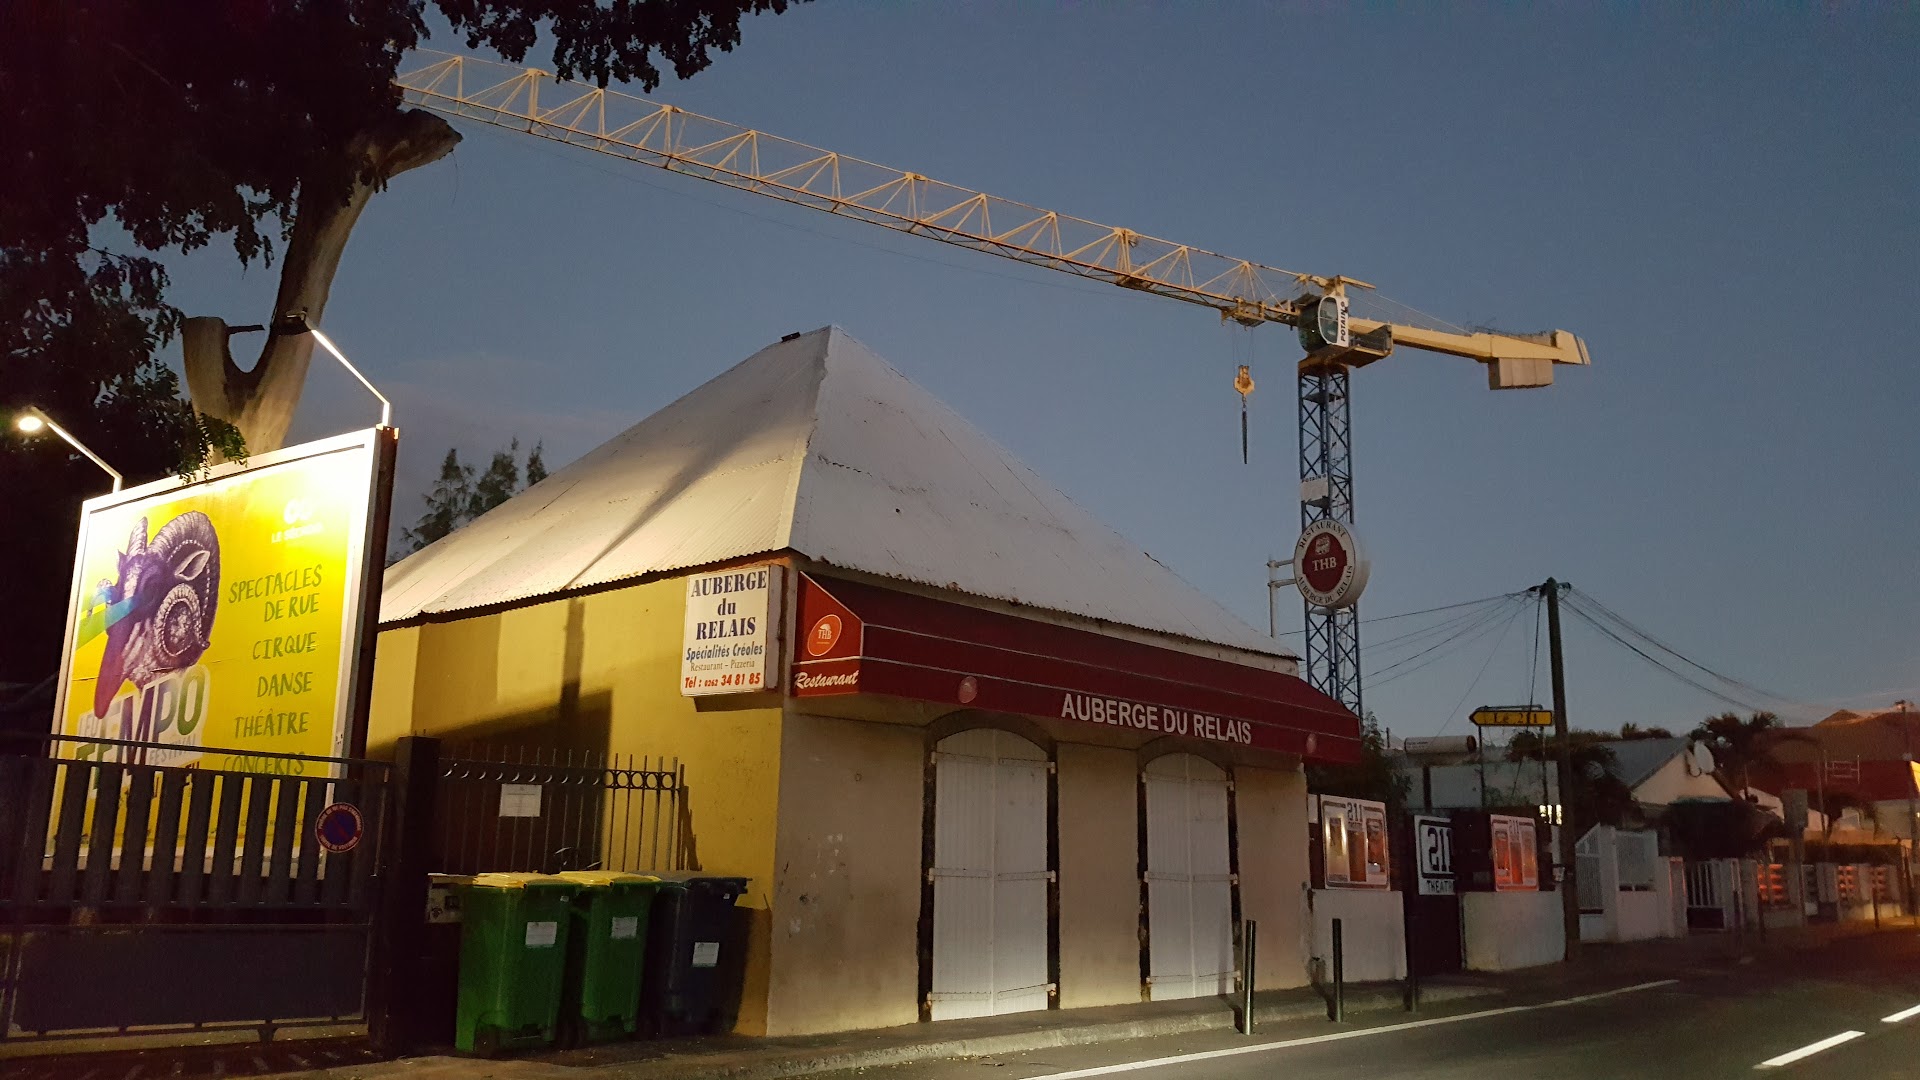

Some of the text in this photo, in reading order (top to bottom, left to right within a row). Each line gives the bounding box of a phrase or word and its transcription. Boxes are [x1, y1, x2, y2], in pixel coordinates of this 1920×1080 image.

[1299, 521, 1347, 548] RESTAURANT
[1312, 556, 1337, 572] THB
[228, 564, 322, 603] SPECTACLES
[691, 571, 767, 597] AUBERGE
[1299, 576, 1323, 603] AUBERGE
[1336, 565, 1353, 597] RELAIS
[264, 592, 320, 622] DE RUE
[717, 597, 736, 616] du
[696, 616, 757, 640] RELAIS
[818, 629, 832, 639] THB
[253, 632, 317, 660] CIRQUE
[686, 641, 763, 662] Spécialités Créoles
[691, 661, 723, 672] Restaurant
[730, 658, 755, 669] Pizzeria
[257, 672, 313, 697] DANSE
[705, 679, 719, 687] 0262
[721, 674, 733, 686] 34
[735, 673, 746, 685] 81
[749, 672, 761, 684] 85
[794, 669, 860, 690] Restaurant
[234, 708, 310, 739] THÉÂTRE
[1061, 692, 1252, 744] AUBERGE DU RELAIS
[1347, 801, 1363, 822] 211
